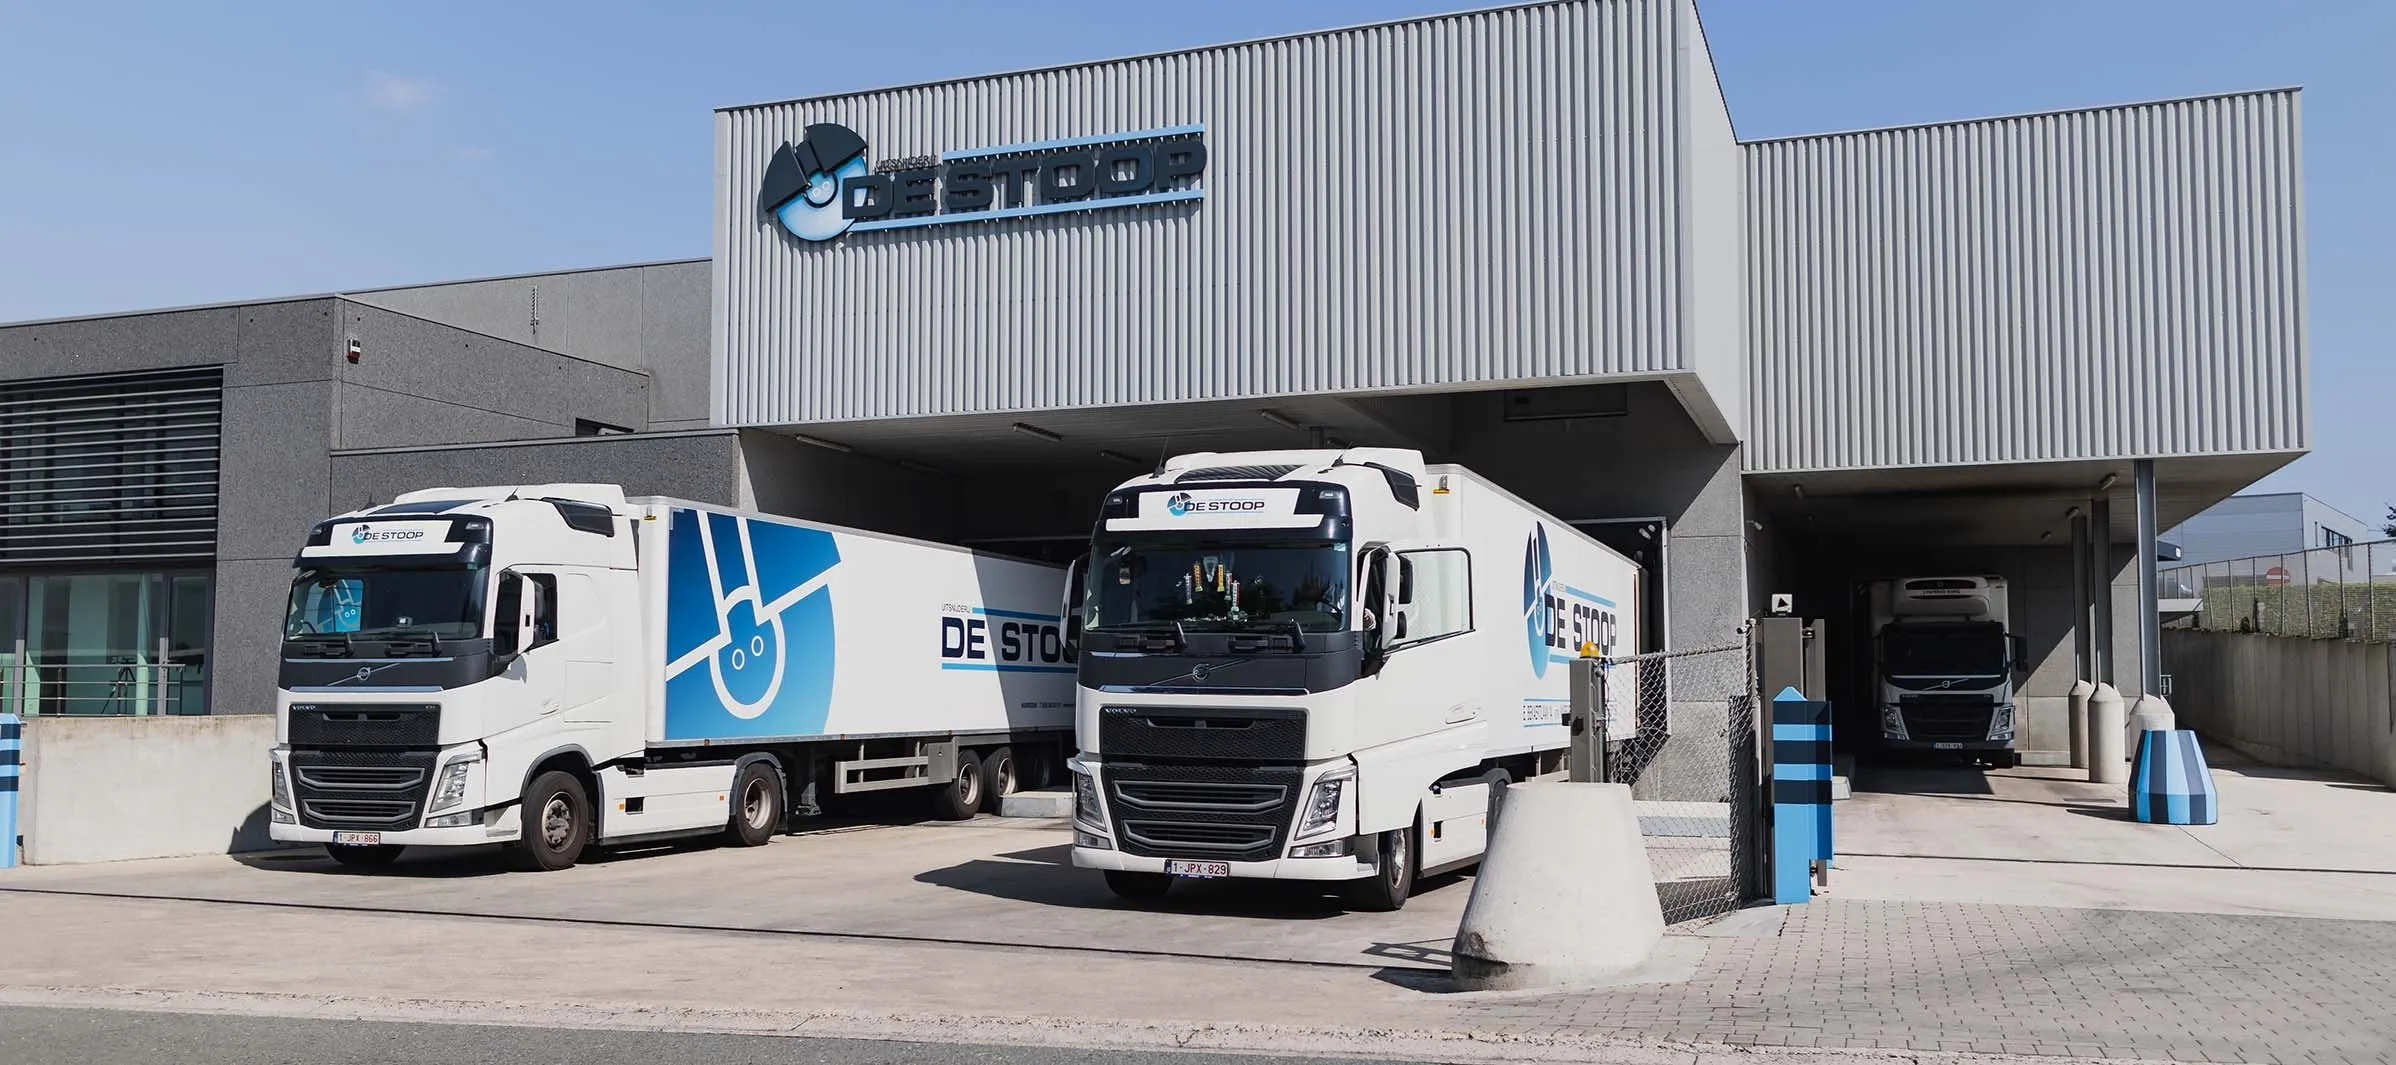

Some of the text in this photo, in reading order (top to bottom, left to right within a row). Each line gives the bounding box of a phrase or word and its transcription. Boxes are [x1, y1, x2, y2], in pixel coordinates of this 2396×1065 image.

[842, 141, 1207, 219] DE STOOP
[1184, 501, 1265, 512] DE STOOP
[363, 531, 424, 541] DE STOOP
[941, 616, 985, 660] DE
[1544, 592, 1616, 656] DE STOOP
[1172, 862, 1227, 875] 1-JPX-829
